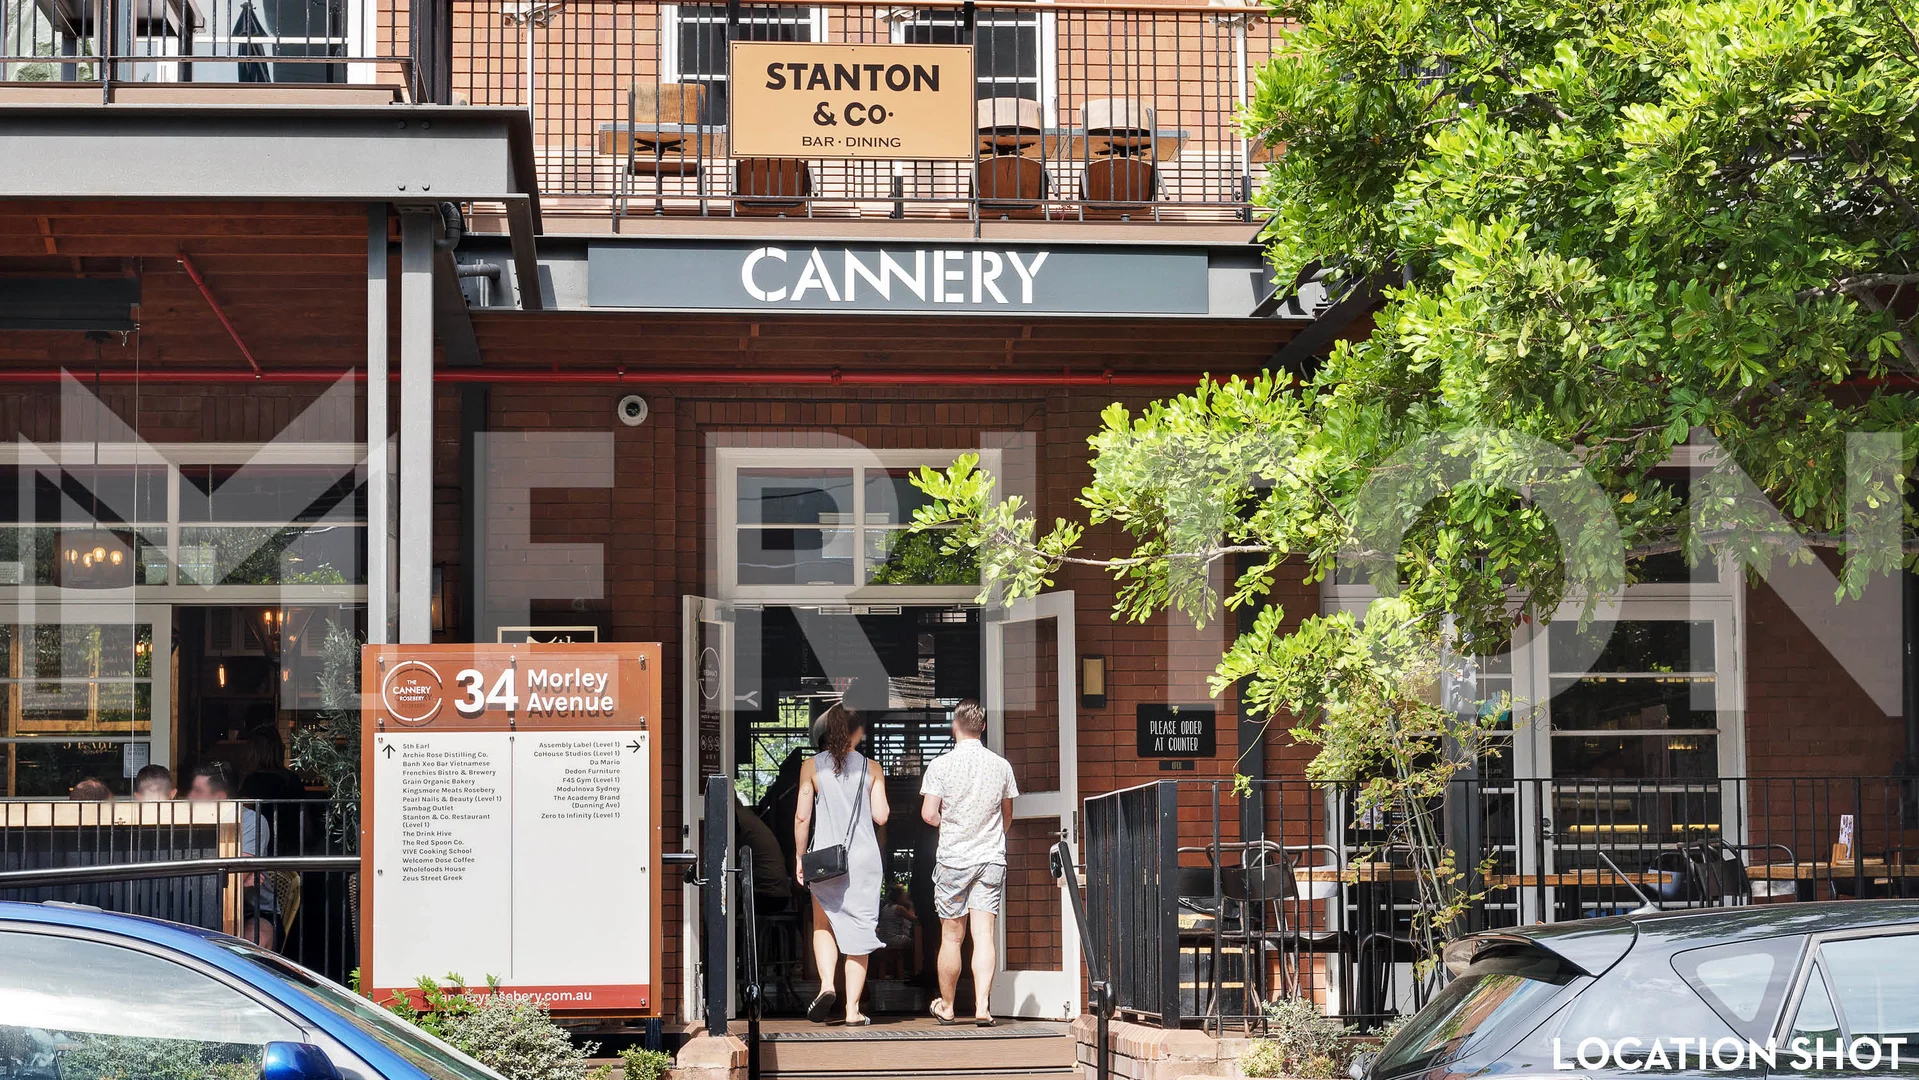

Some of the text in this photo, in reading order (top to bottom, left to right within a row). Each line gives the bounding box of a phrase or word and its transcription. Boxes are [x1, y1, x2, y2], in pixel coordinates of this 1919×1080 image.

[765, 62, 940, 92] STANTON
[813, 101, 838, 126] &
[802, 135, 901, 148] BAR DINING
[741, 246, 1050, 304] CANNERY
[392, 686, 431, 694] CANNERY
[454, 667, 608, 713] 34 Morley
[526, 692, 614, 711] Avenue
[1150, 720, 1202, 735] PLEASE ORDER
[1154, 737, 1199, 751] AT COUNTER
[423, 778, 450, 786] Organic
[577, 777, 591, 785] Gym
[464, 787, 495, 795] Rosebery
[557, 785, 620, 795] Modulnova Sydney
[422, 796, 439, 804] Nails
[450, 796, 473, 804] Beauty
[567, 795, 598, 803] Academy
[402, 805, 431, 813] Sambag
[572, 801, 604, 809] (Dunning
[566, 812, 591, 820] Infinity
[419, 847, 447, 856] Cooking
